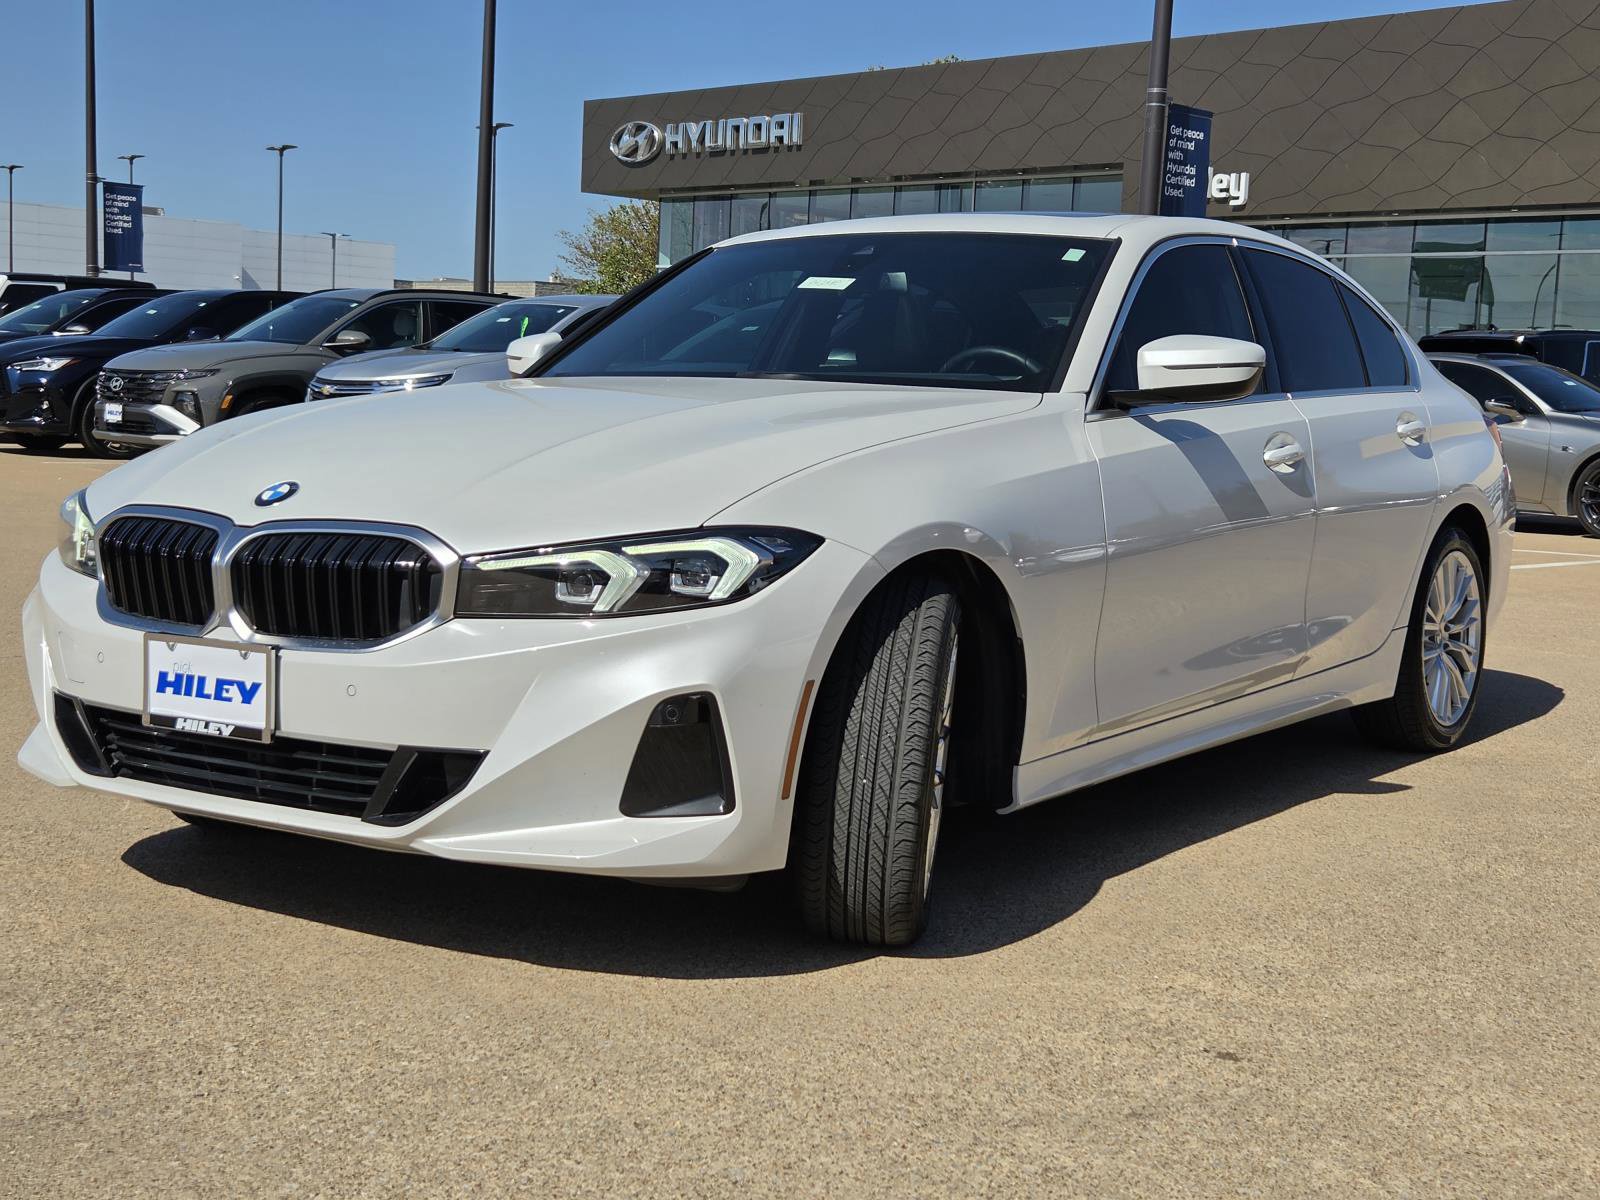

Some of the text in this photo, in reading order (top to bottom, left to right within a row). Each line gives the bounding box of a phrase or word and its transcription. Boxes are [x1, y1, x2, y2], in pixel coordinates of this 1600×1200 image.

[665, 112, 803, 155] HYUNDAI
[1170, 124, 1204, 140] Get peace
[1169, 137, 1195, 150] of mind
[1168, 149, 1184, 161] with
[1166, 161, 1197, 175] Hyundai
[1165, 173, 1196, 187] Certified
[1164, 186, 1184, 197] Used.
[156, 670, 262, 705] HILEY
[175, 717, 235, 737] HILEY
